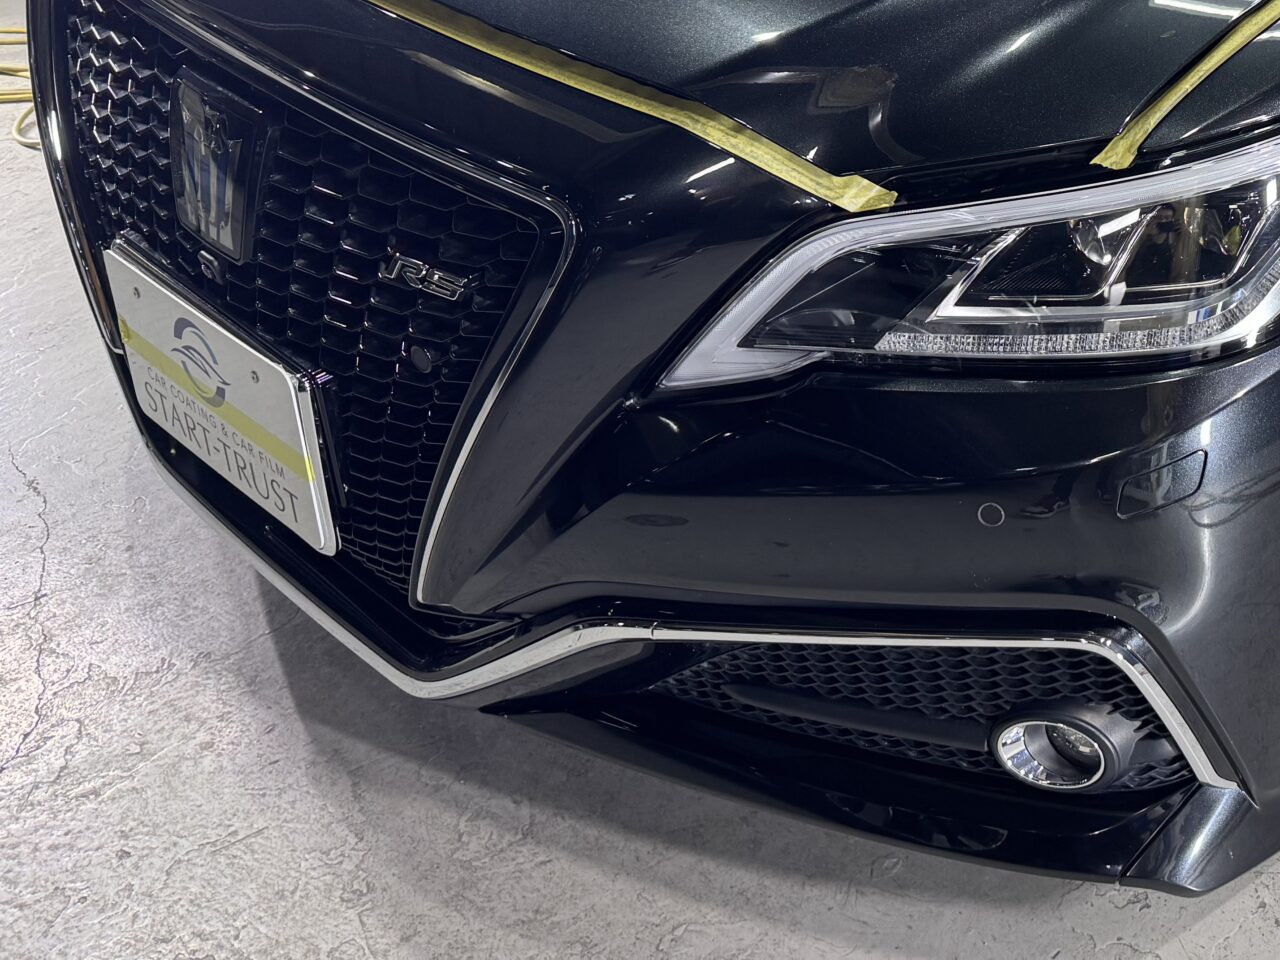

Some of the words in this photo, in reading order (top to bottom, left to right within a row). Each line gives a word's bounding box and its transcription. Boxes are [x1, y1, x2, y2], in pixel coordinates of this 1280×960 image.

[380, 253, 467, 301] RS
[144, 381, 298, 523] START-TRUST
[147, 366, 167, 391] CAR
[171, 386, 217, 428] COATING
[221, 423, 228, 437] &
[232, 431, 254, 457] CAR
[258, 451, 286, 480] FILM
